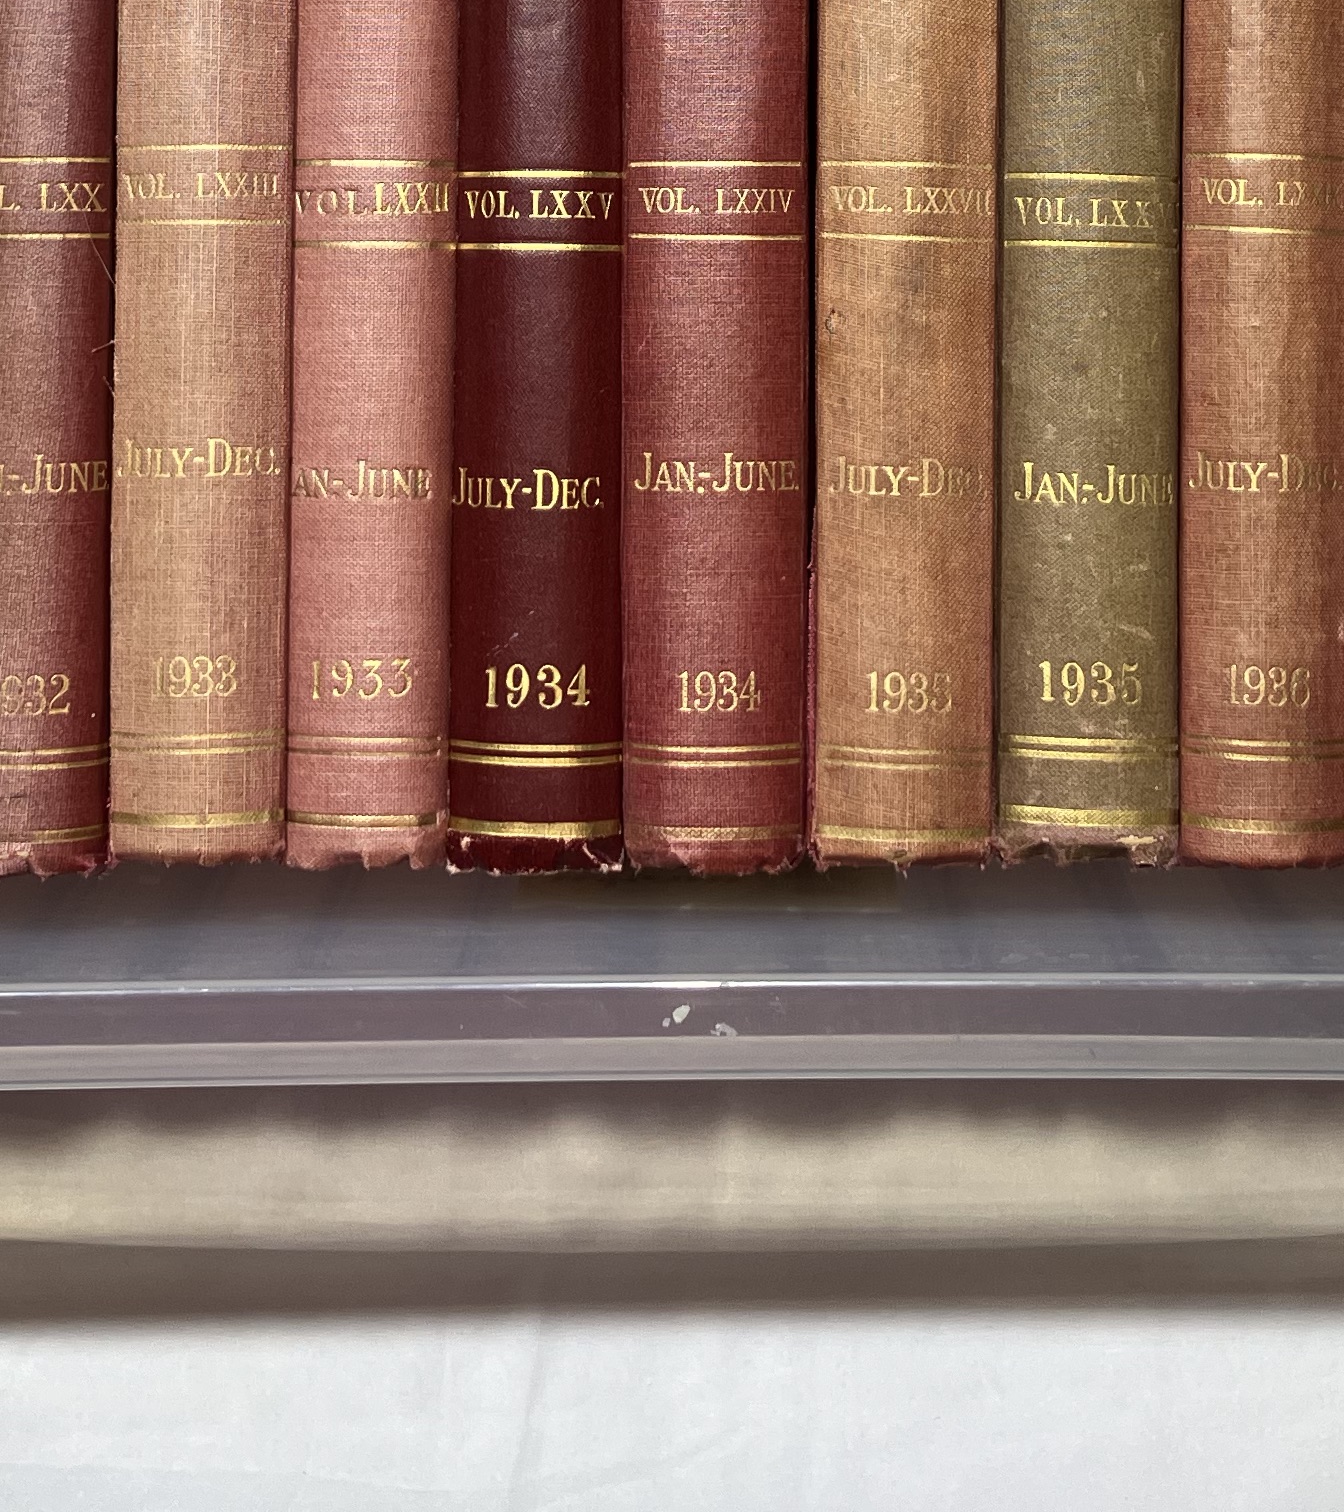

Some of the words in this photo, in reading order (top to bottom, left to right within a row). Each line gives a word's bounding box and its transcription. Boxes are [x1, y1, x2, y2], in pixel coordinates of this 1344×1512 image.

[40, 182, 107, 213] LXX
[122, 171, 182, 200] VOL.
[373, 181, 450, 215] LXXII
[464, 190, 521, 220] VOL.
[529, 189, 615, 220] LXXV
[638, 187, 701, 214] VOL.
[715, 187, 795, 213] LXXIV
[830, 186, 893, 214] VOL.
[1201, 178, 1264, 207] VOL.
[1014, 196, 1081, 227] VOL.
[117, 438, 282, 479] JULY-DEC.
[292, 458, 434, 500] AN-JUNE
[452, 467, 605, 511] JULY-DEC.
[155, 655, 238, 699] 1933
[312, 658, 413, 700] 1933
[485, 663, 590, 710] 1934
[678, 670, 761, 713] 1934
[1038, 660, 1144, 707] 1935
[1228, 664, 1311, 708] 1936
